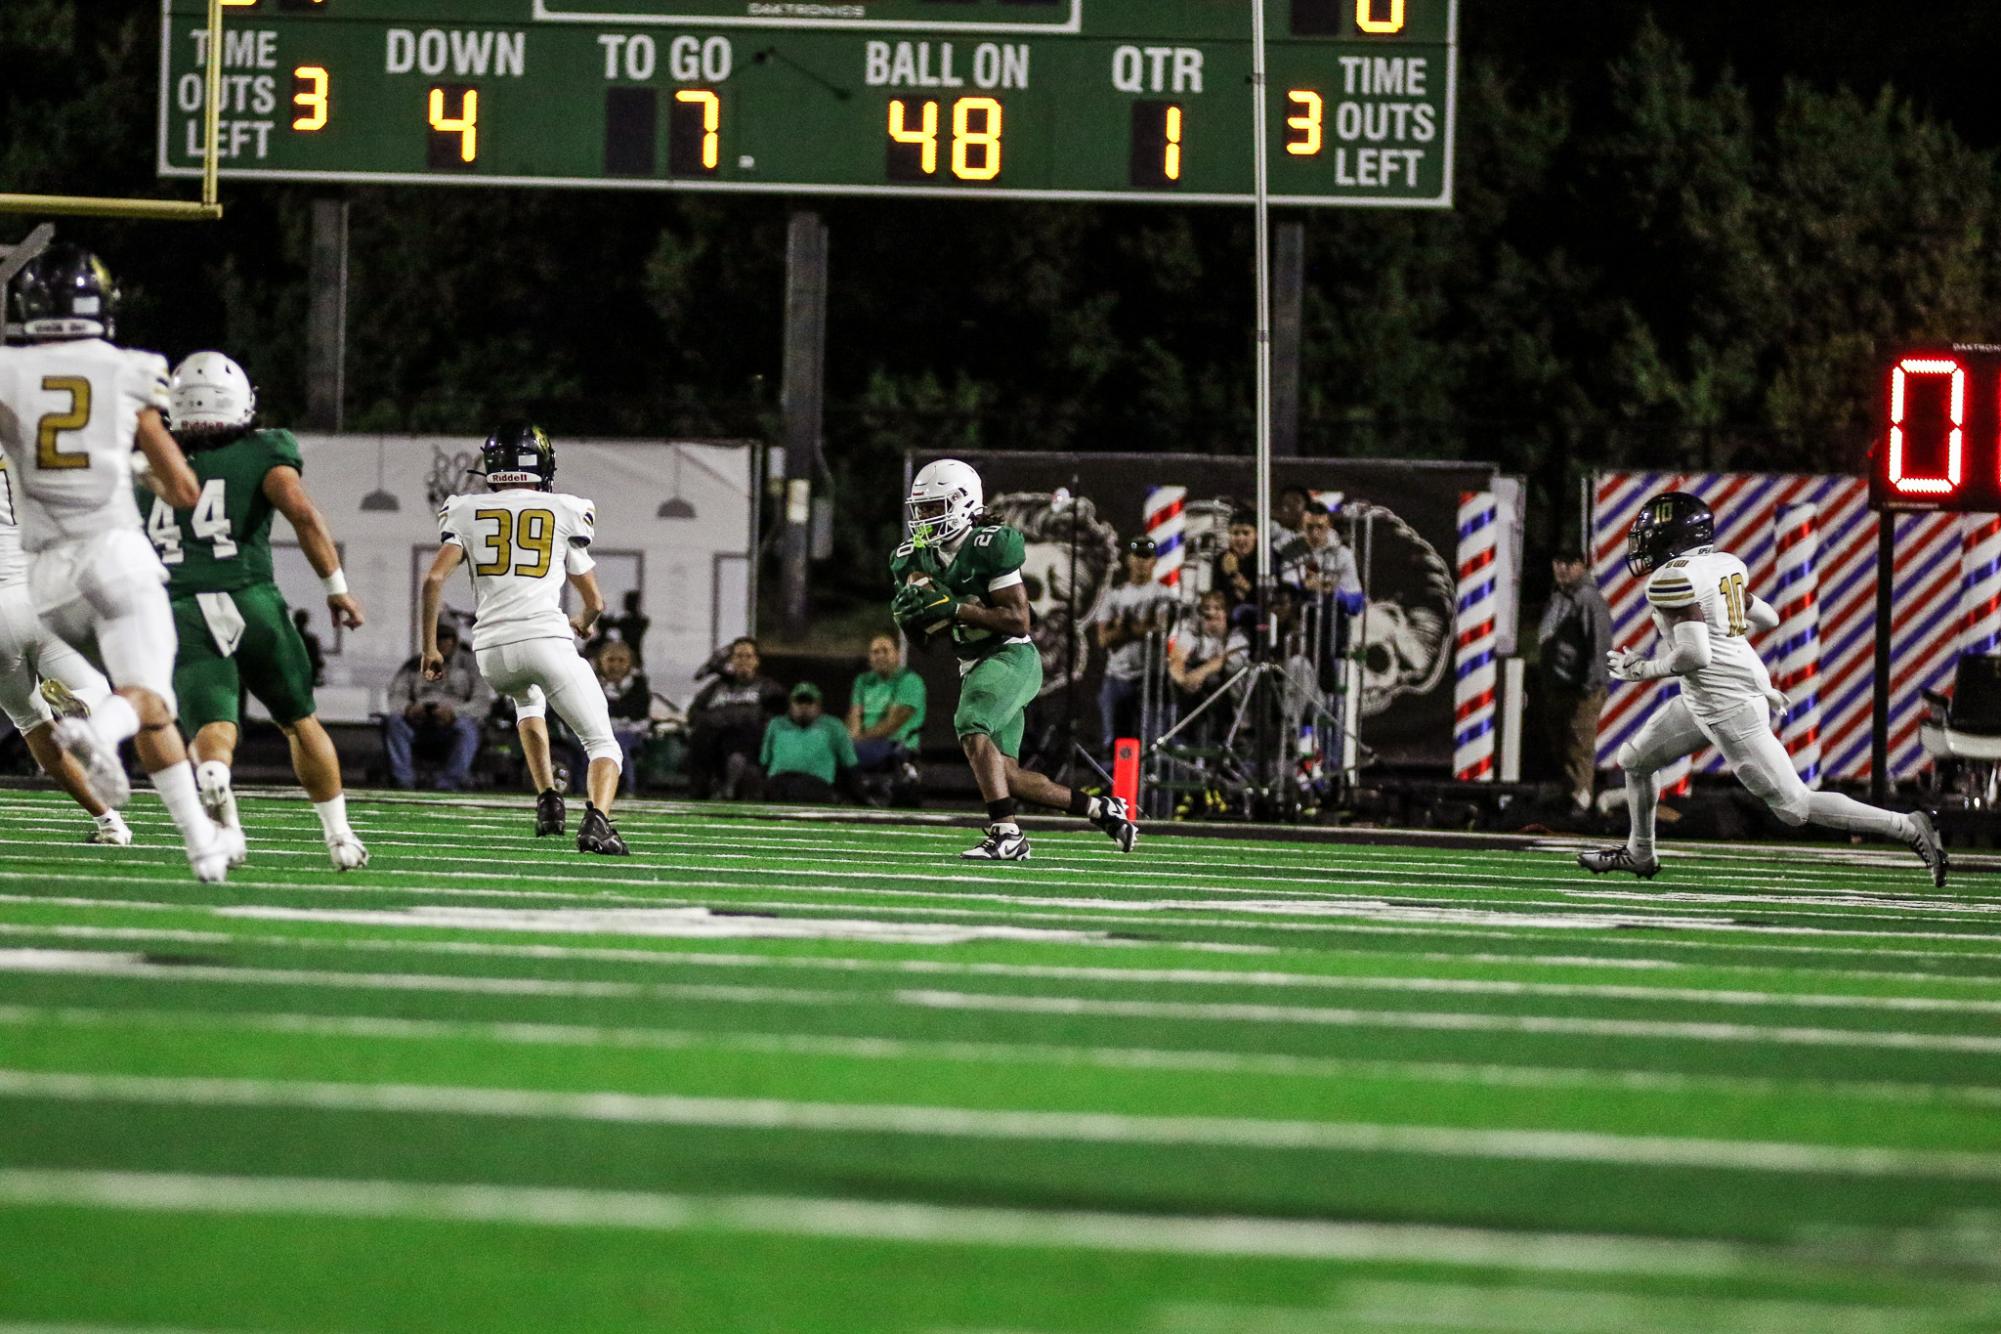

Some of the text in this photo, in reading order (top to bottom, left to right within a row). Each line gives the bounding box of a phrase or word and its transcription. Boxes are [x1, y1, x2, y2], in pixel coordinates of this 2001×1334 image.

[190, 29, 278, 68] TME
[386, 28, 526, 77] DOWN
[598, 34, 733, 83] TO GO
[864, 40, 1030, 90] BALL ON
[1111, 45, 1204, 94] QTR
[1338, 56, 1427, 95] TIME
[293, 67, 328, 131] 3
[428, 88, 478, 162] 4
[1286, 90, 1323, 155] 3
[1336, 101, 1436, 142] OUTS
[676, 90, 719, 169] 7
[888, 97, 1002, 180] 48
[1164, 106, 1181, 180] 1
[1334, 147, 1425, 188] LEFT
[36, 375, 92, 470] 2
[492, 474, 528, 482] Riddell
[147, 479, 239, 564] 44
[1654, 502, 1674, 525] 10
[475, 508, 556, 579] 39
[1719, 571, 1748, 638] 10
